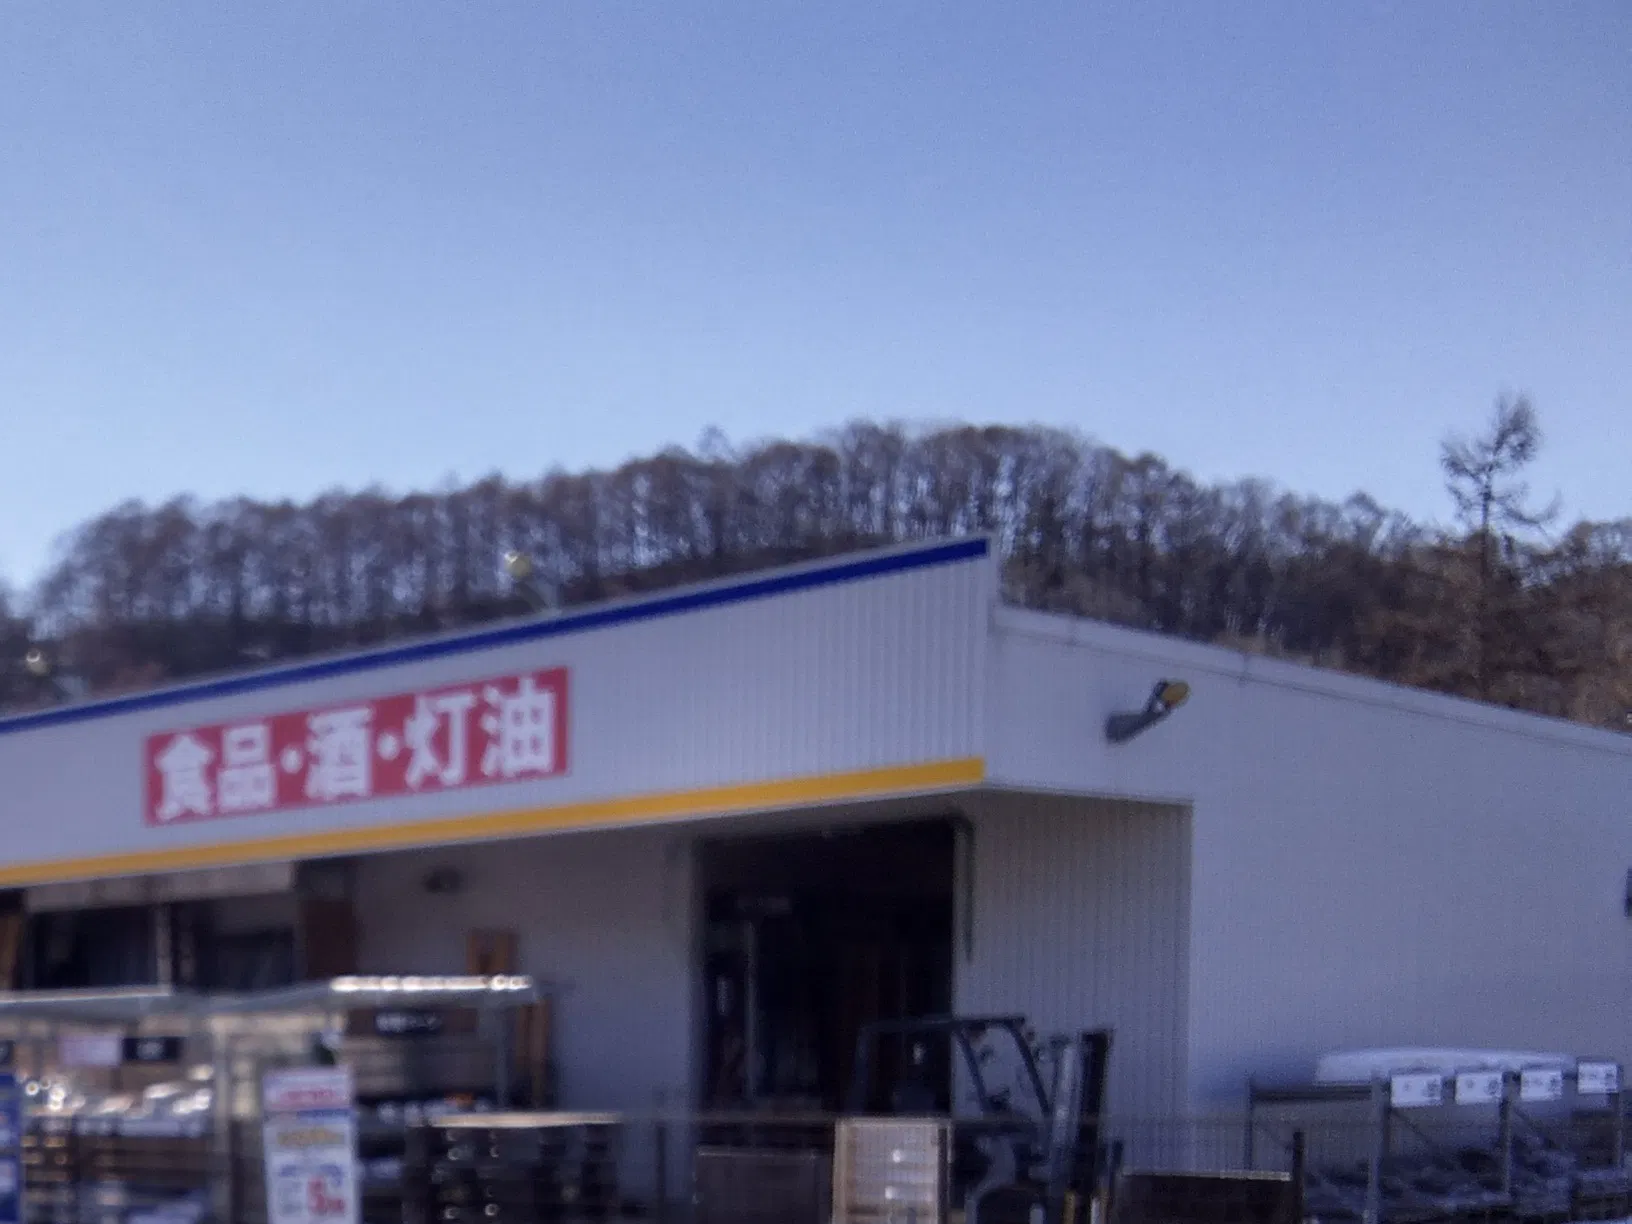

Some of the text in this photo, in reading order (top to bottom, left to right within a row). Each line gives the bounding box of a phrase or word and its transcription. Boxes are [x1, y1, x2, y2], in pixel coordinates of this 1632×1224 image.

[156, 676, 558, 821] 食品・酒・灯油
